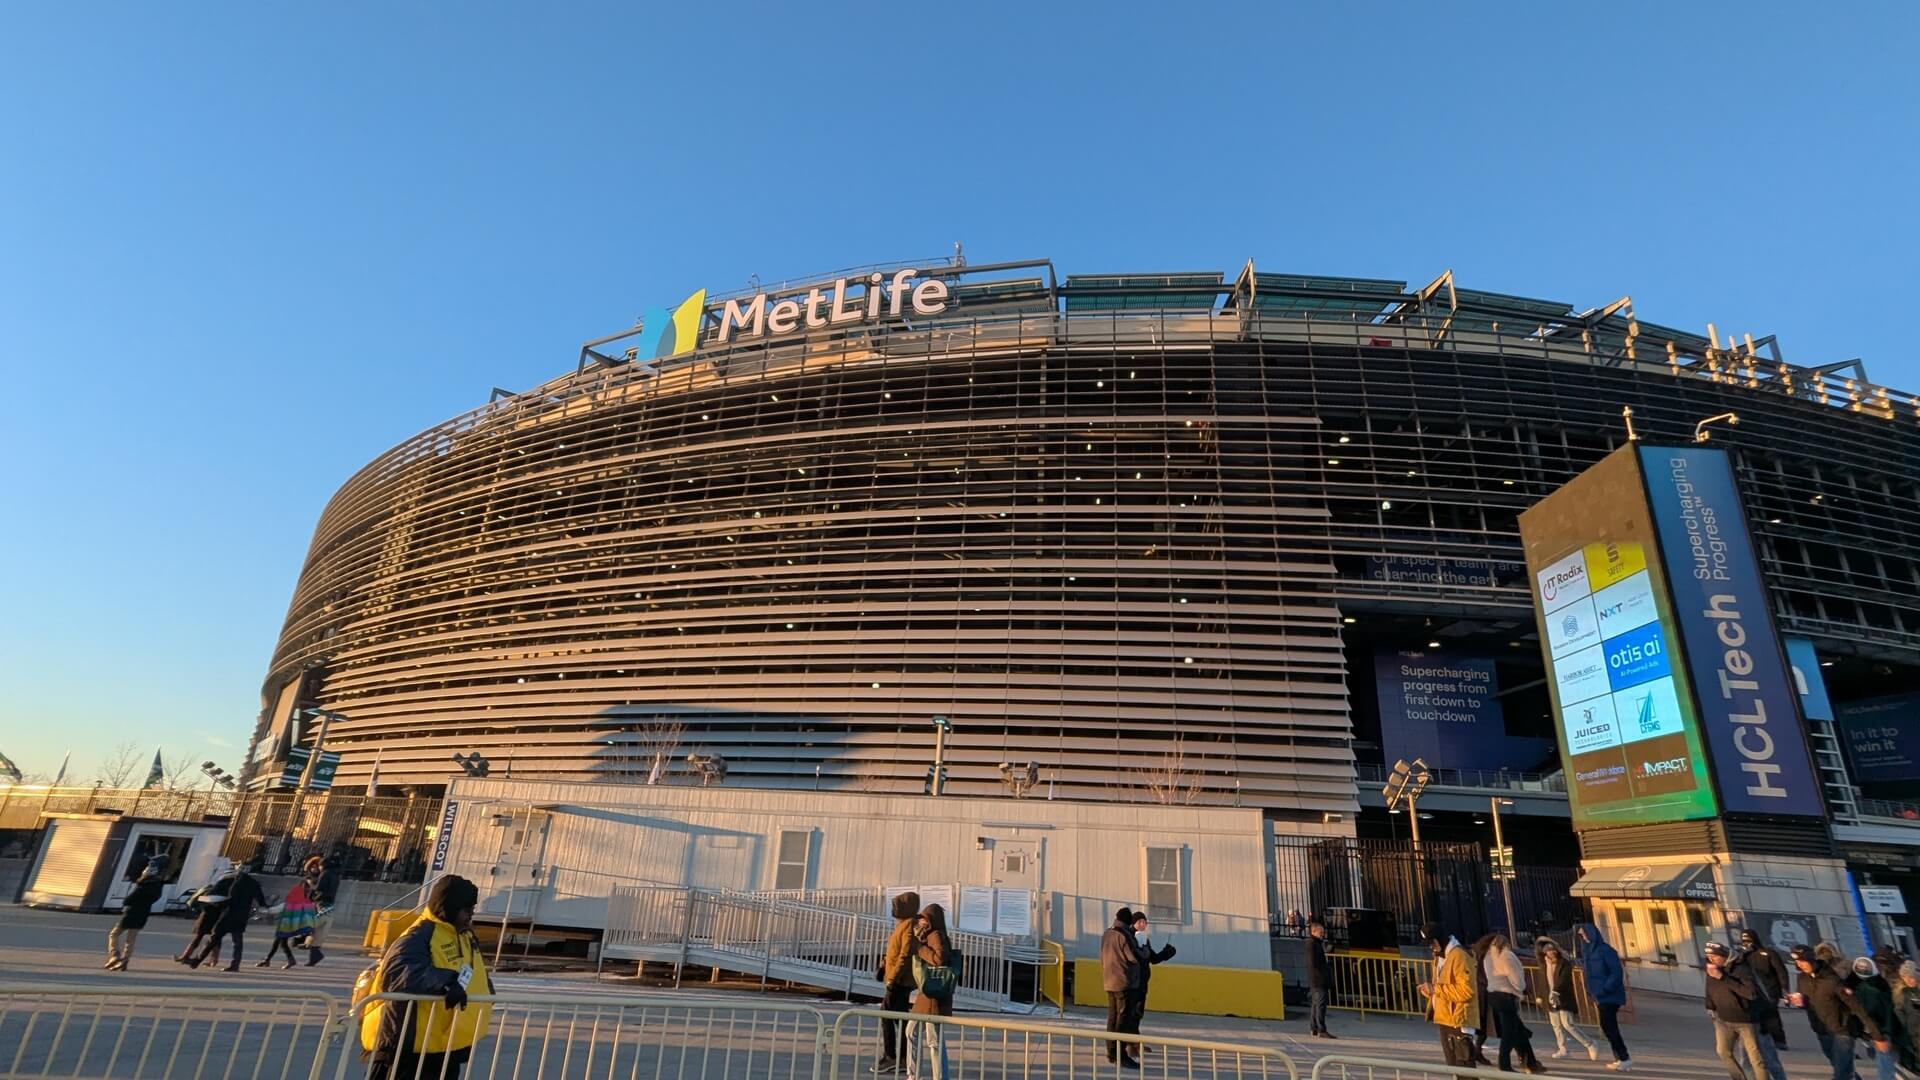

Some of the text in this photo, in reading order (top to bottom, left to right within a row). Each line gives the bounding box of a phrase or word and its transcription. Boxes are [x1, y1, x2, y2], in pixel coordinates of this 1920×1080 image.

[717, 268, 949, 343] MetLife
[1670, 458, 1710, 580] Supercharging
[1444, 570, 1467, 583] the
[1546, 577, 1556, 590] IT
[1557, 565, 1584, 584] Radix
[1600, 602, 1623, 620] NXT
[1611, 634, 1660, 668] otis ai
[1401, 664, 1490, 682] Supercharging
[1403, 680, 1488, 694] progress from
[1404, 693, 1481, 708] first down to
[1704, 594, 1787, 798] HCLTech
[1407, 708, 1476, 723] touchdown
[1574, 723, 1610, 739] JUICED
[1850, 727, 1898, 740] In it to
[1855, 740, 1881, 752] win
[1643, 758, 1686, 774] IMPACT
[434, 804, 457, 869] WILLSCOT
[1686, 889, 1715, 898] OFFICE
[1695, 882, 1714, 890] BOX
